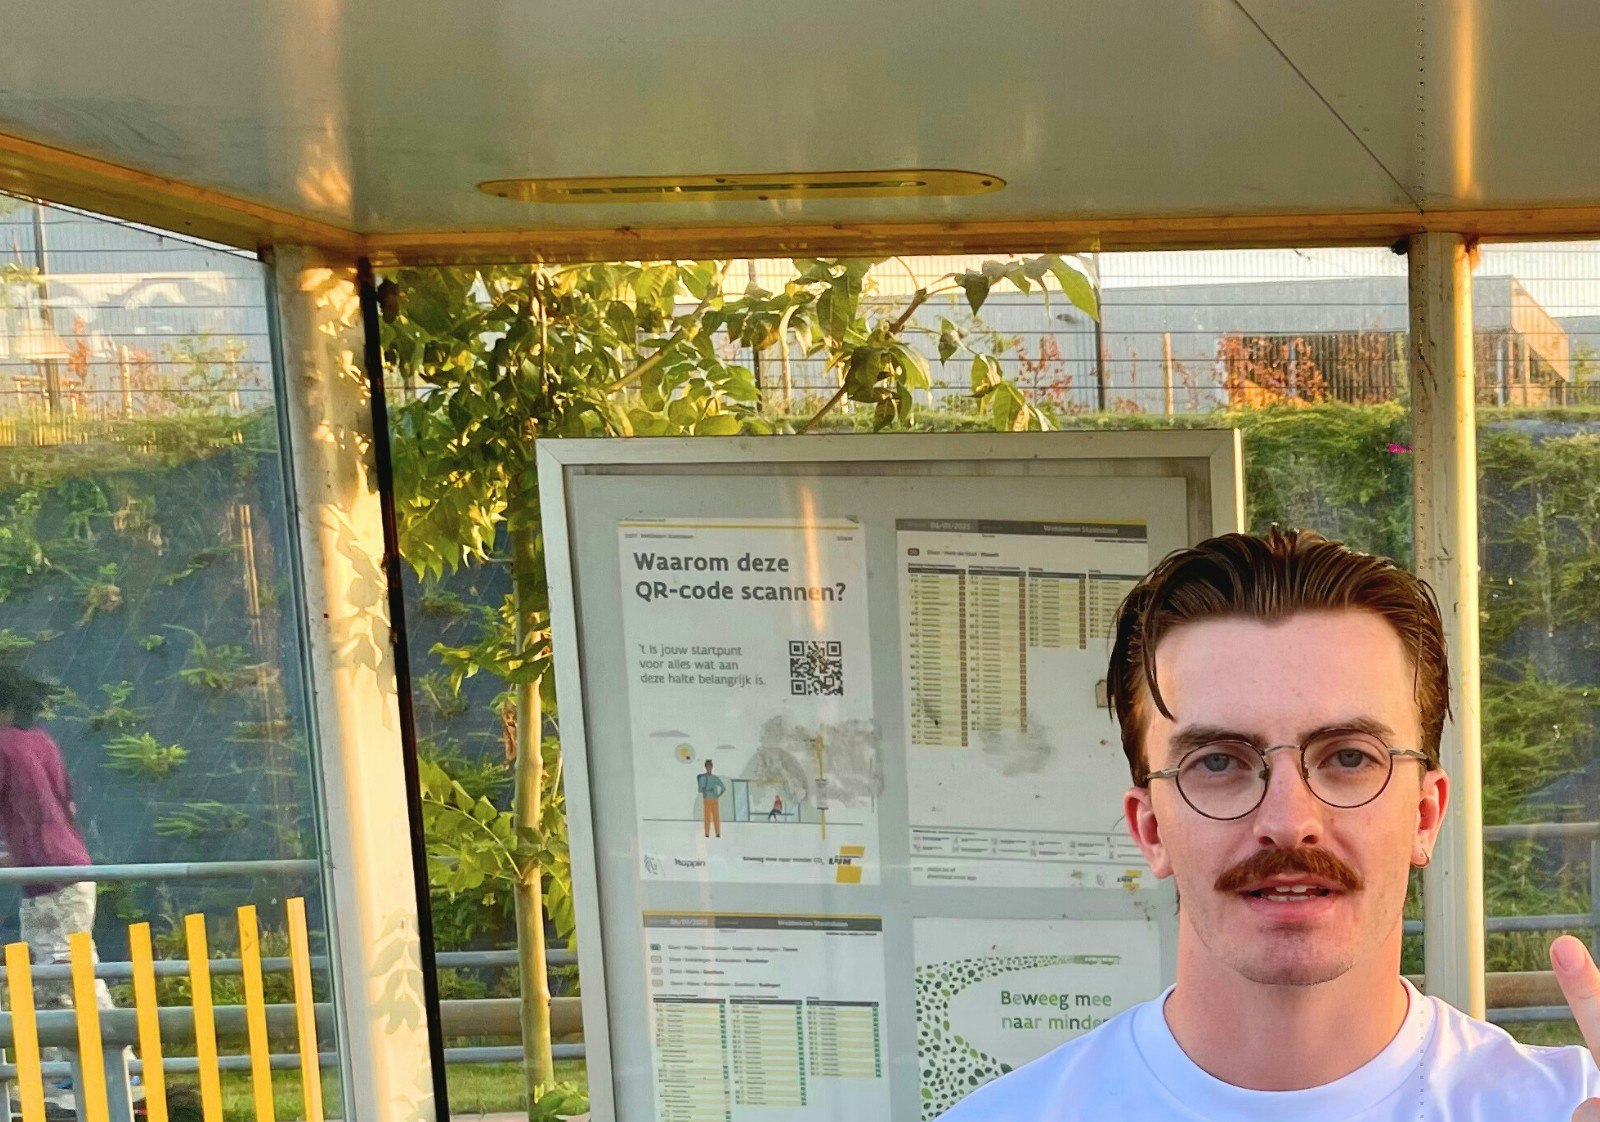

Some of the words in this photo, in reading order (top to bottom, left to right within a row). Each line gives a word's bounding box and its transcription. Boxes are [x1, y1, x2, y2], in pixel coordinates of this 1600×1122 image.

[633, 552, 729, 572] Waarom
[737, 552, 789, 572] deze
[635, 581, 734, 602] QR-code
[741, 582, 846, 602] scannen?
[660, 645, 688, 658] jouw
[692, 645, 743, 657] startpunt
[640, 660, 664, 670] voor
[668, 658, 691, 670] alles
[694, 659, 716, 670] wat
[719, 661, 739, 670] aan
[641, 673, 665, 685] deze
[668, 673, 695, 685] halte
[698, 673, 751, 688] belangrijk
[1000, 990, 1069, 1010] Beweeg
[1075, 993, 1112, 1007] mee
[1001, 1016, 1042, 1029] naar
